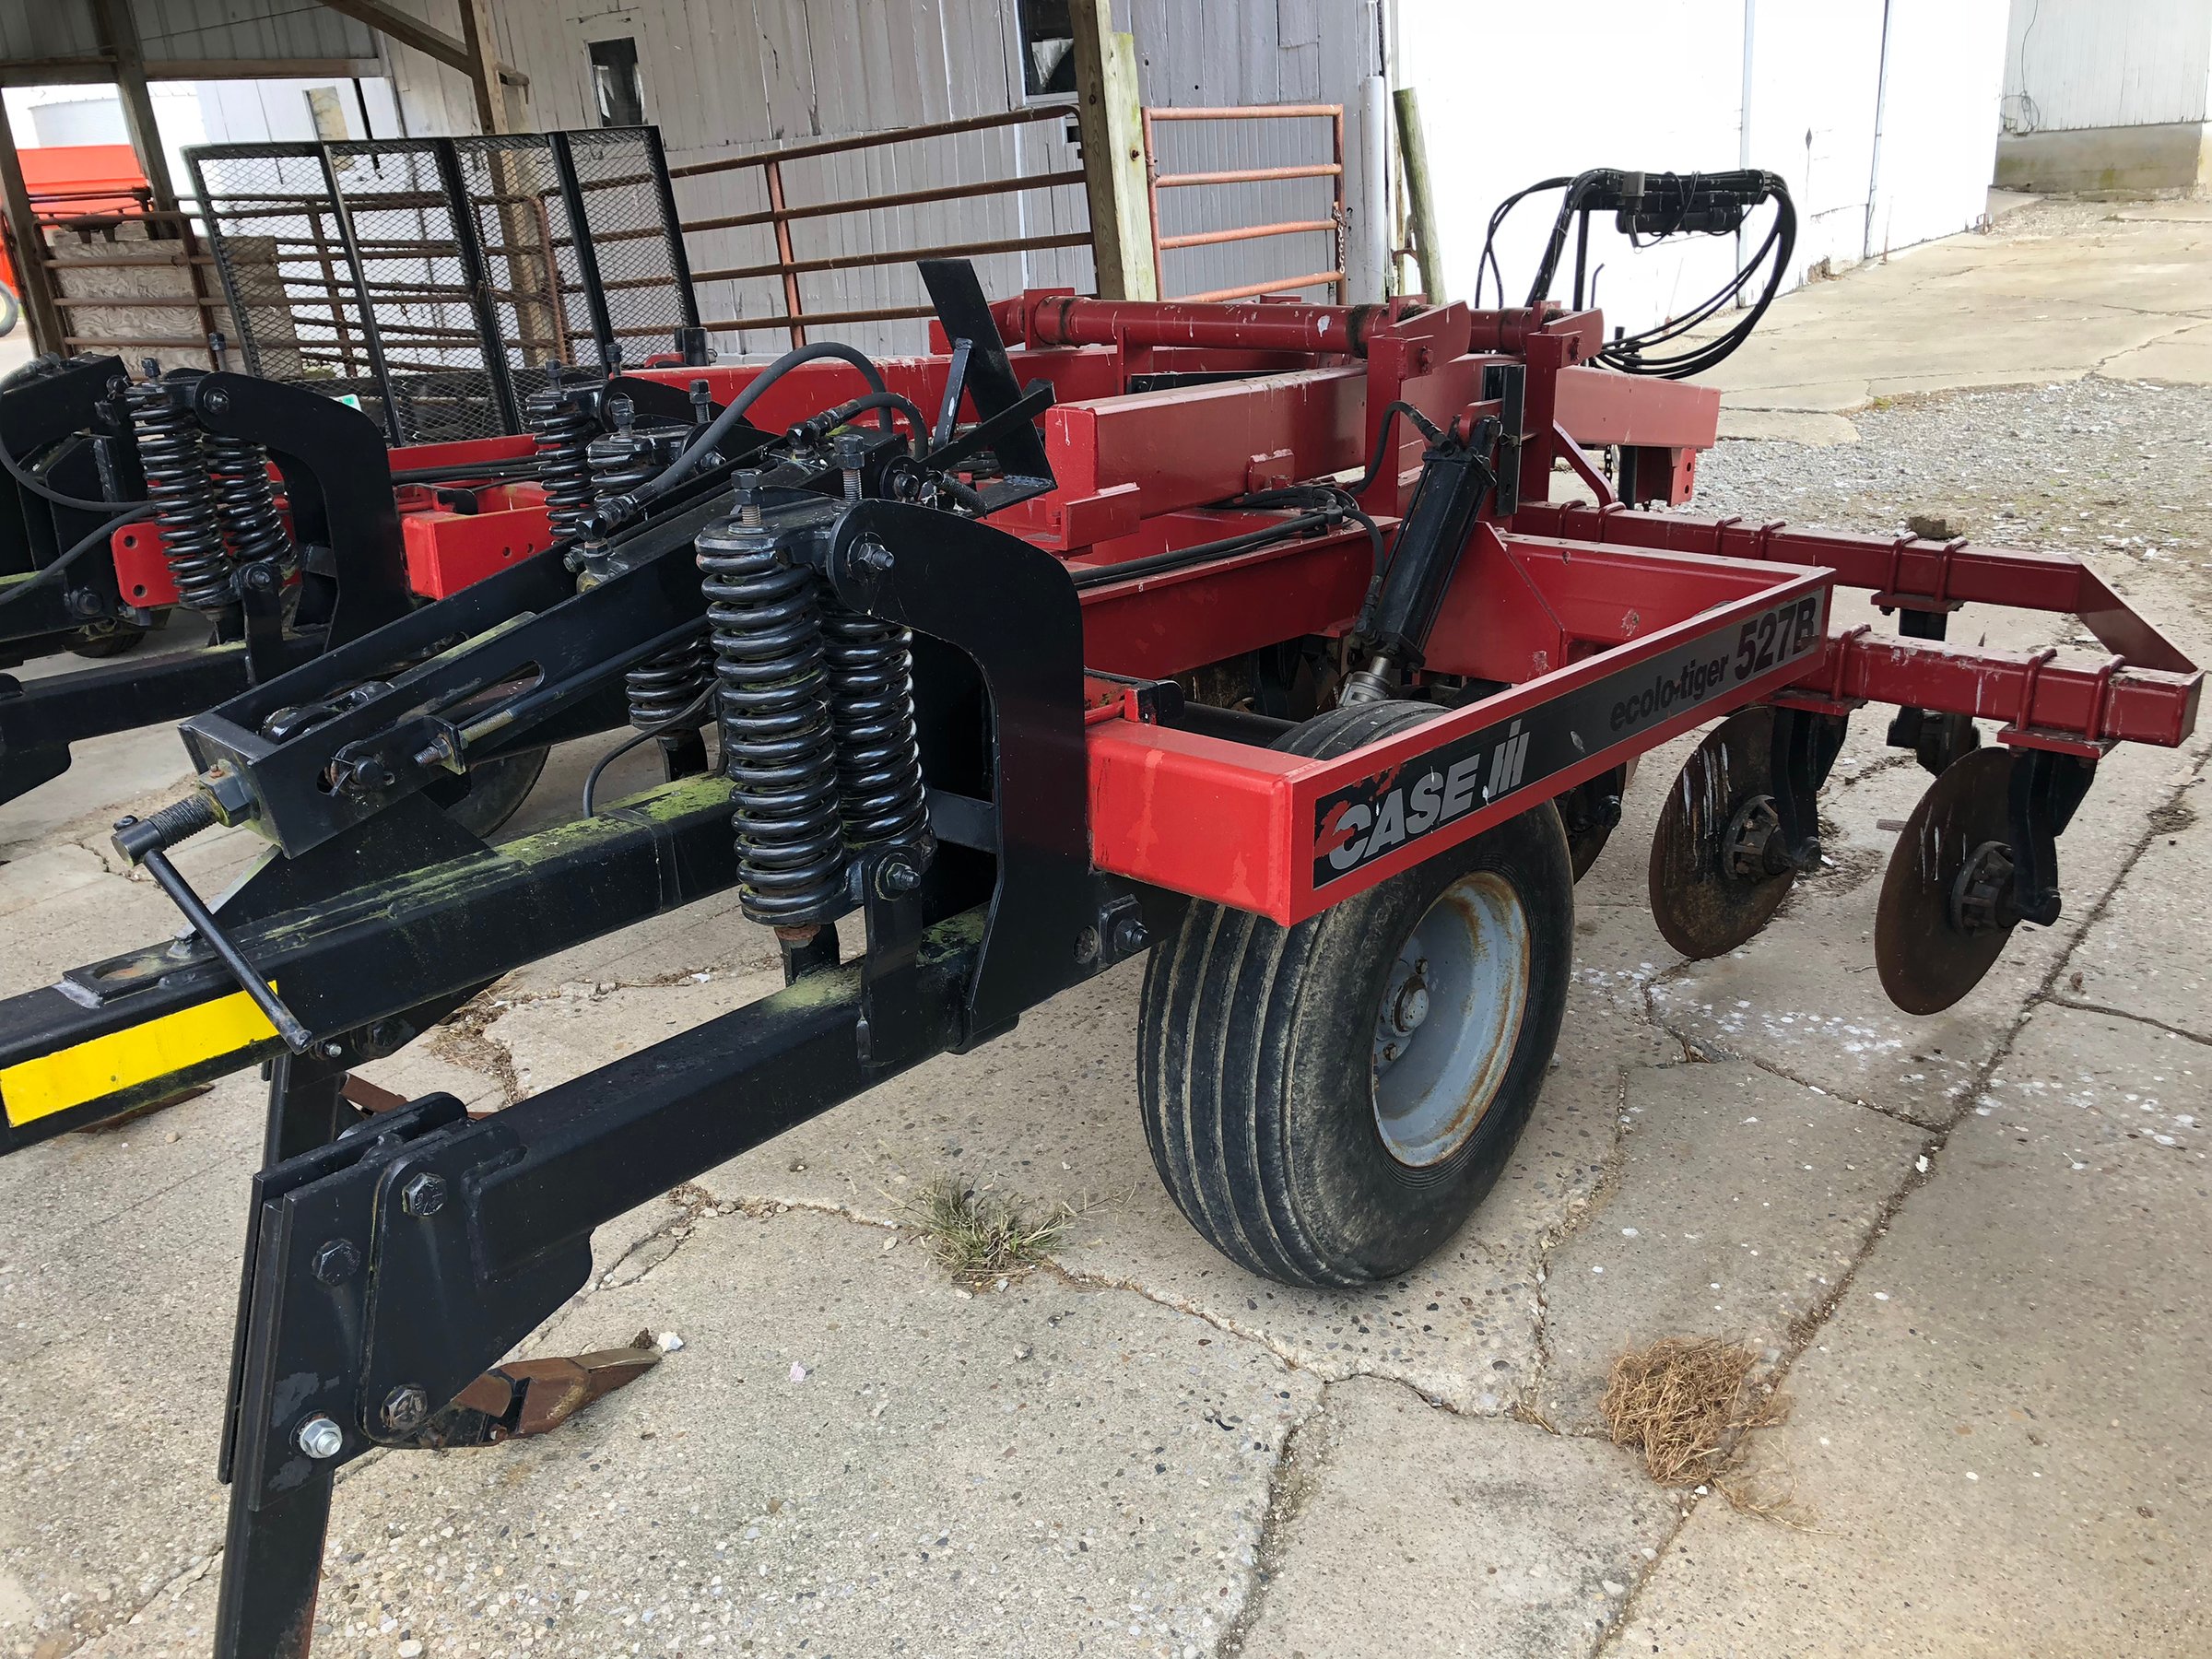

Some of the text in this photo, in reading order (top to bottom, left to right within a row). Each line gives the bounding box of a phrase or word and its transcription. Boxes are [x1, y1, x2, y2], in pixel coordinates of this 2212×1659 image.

[1328, 753, 1481, 870] CASE
[1609, 654, 1730, 732] ecolo-tiger
[1735, 596, 1817, 680] 527B
